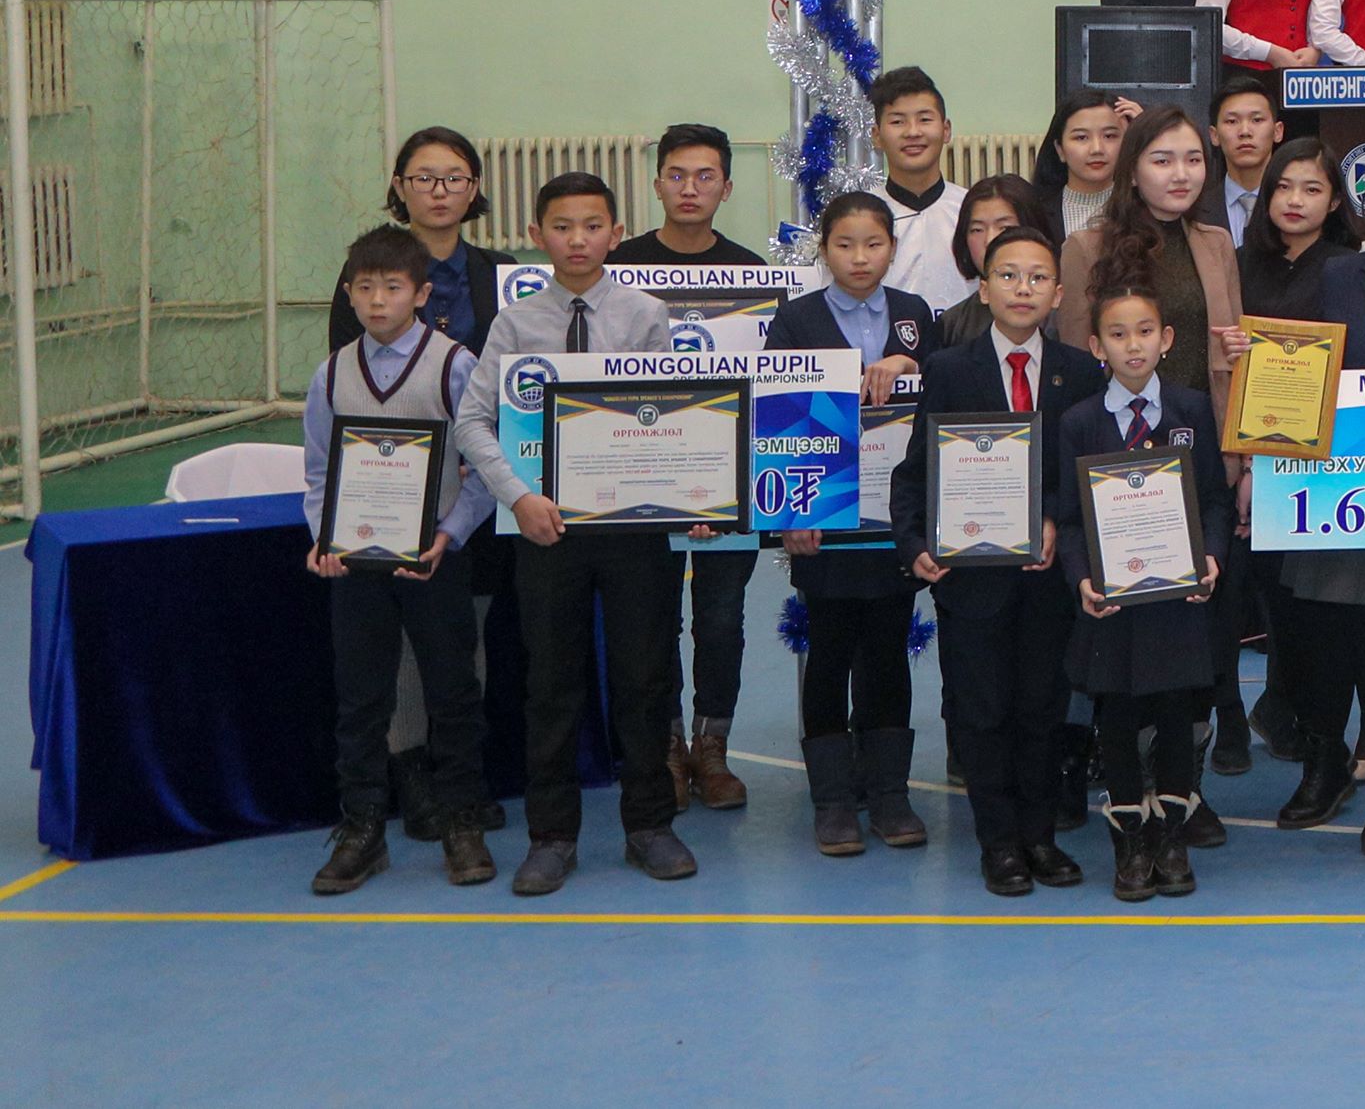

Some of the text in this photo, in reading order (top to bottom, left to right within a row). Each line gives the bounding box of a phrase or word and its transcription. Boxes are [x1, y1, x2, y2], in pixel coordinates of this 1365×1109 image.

[743, 269, 803, 286] PUPIL
[604, 355, 824, 376] MONGOLIAN PUPIL
[1274, 457, 1350, 474] ИЛТГЭХ
